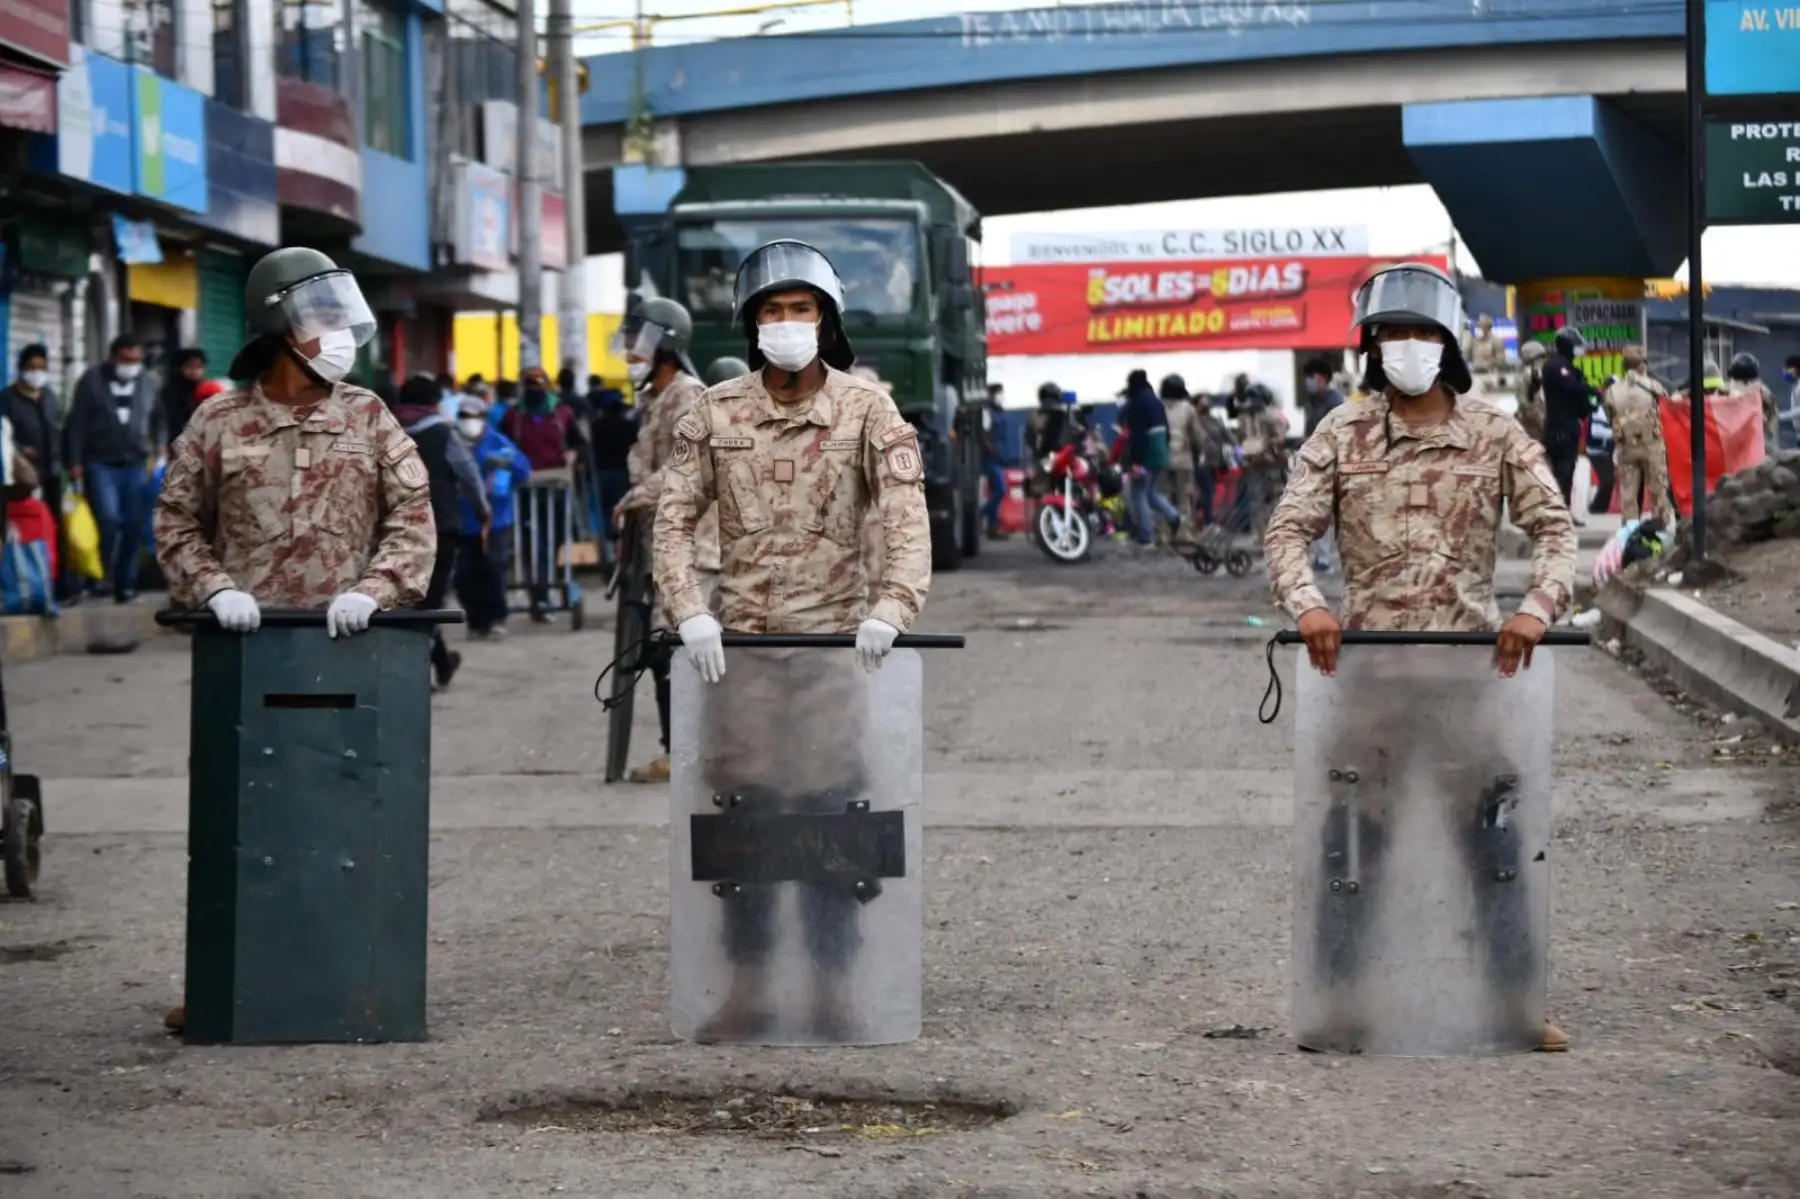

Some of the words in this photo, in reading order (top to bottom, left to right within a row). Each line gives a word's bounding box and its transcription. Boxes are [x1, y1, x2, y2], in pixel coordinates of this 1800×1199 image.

[1740, 8, 1770, 31] AV.
[1743, 171, 1788, 188] LAS
[1161, 231, 1215, 255] C.C.
[1223, 228, 1303, 254] SIGLO
[1312, 227, 1346, 251] XX
[1086, 307, 1226, 342] ILIMITADO
